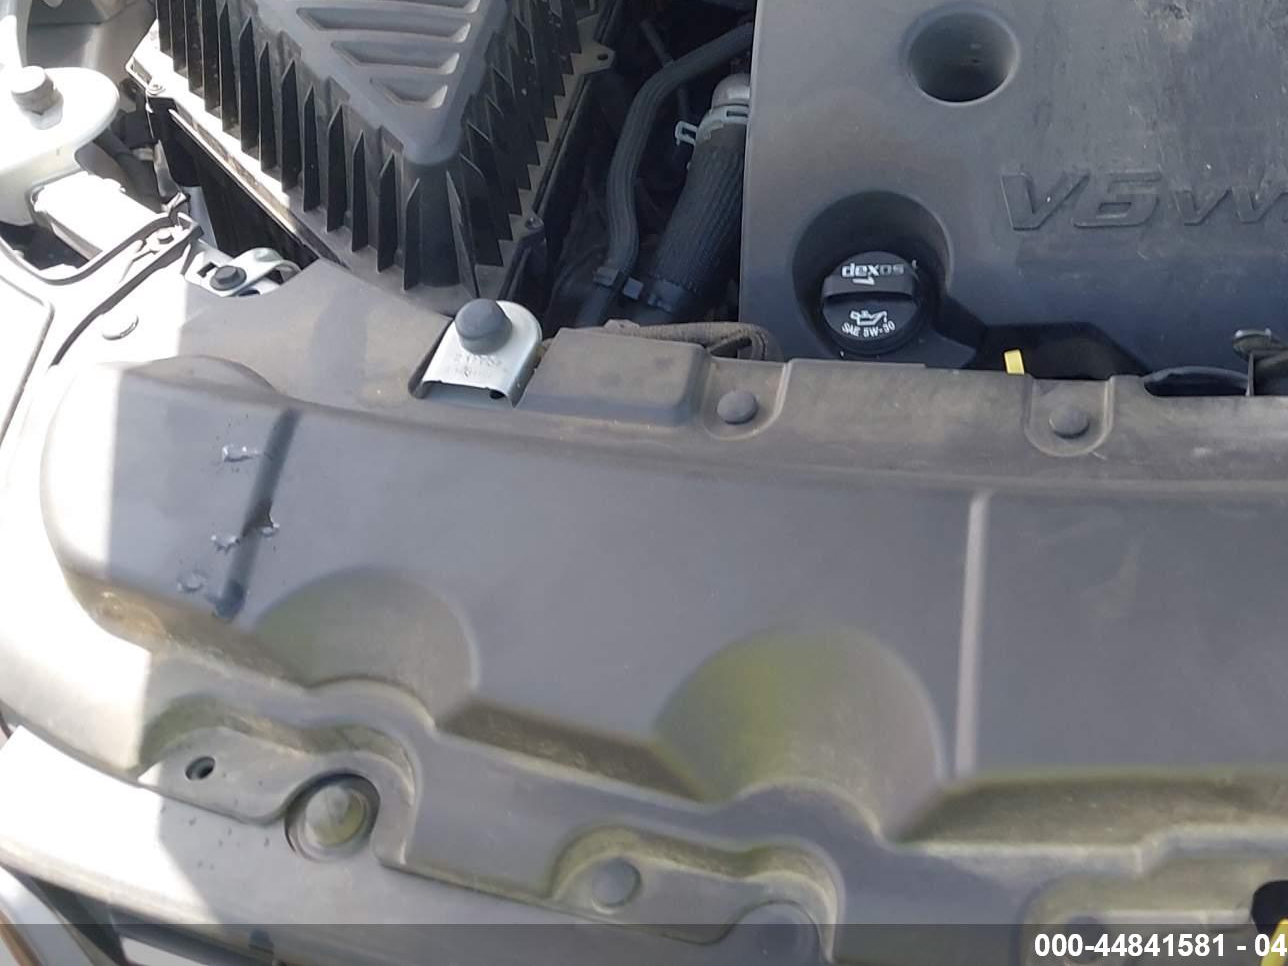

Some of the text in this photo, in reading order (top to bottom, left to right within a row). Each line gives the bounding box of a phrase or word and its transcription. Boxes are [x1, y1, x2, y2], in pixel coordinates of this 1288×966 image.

[1000, 171, 1162, 231] V6
[841, 263, 904, 277] dexos
[841, 322, 861, 337] SAE
